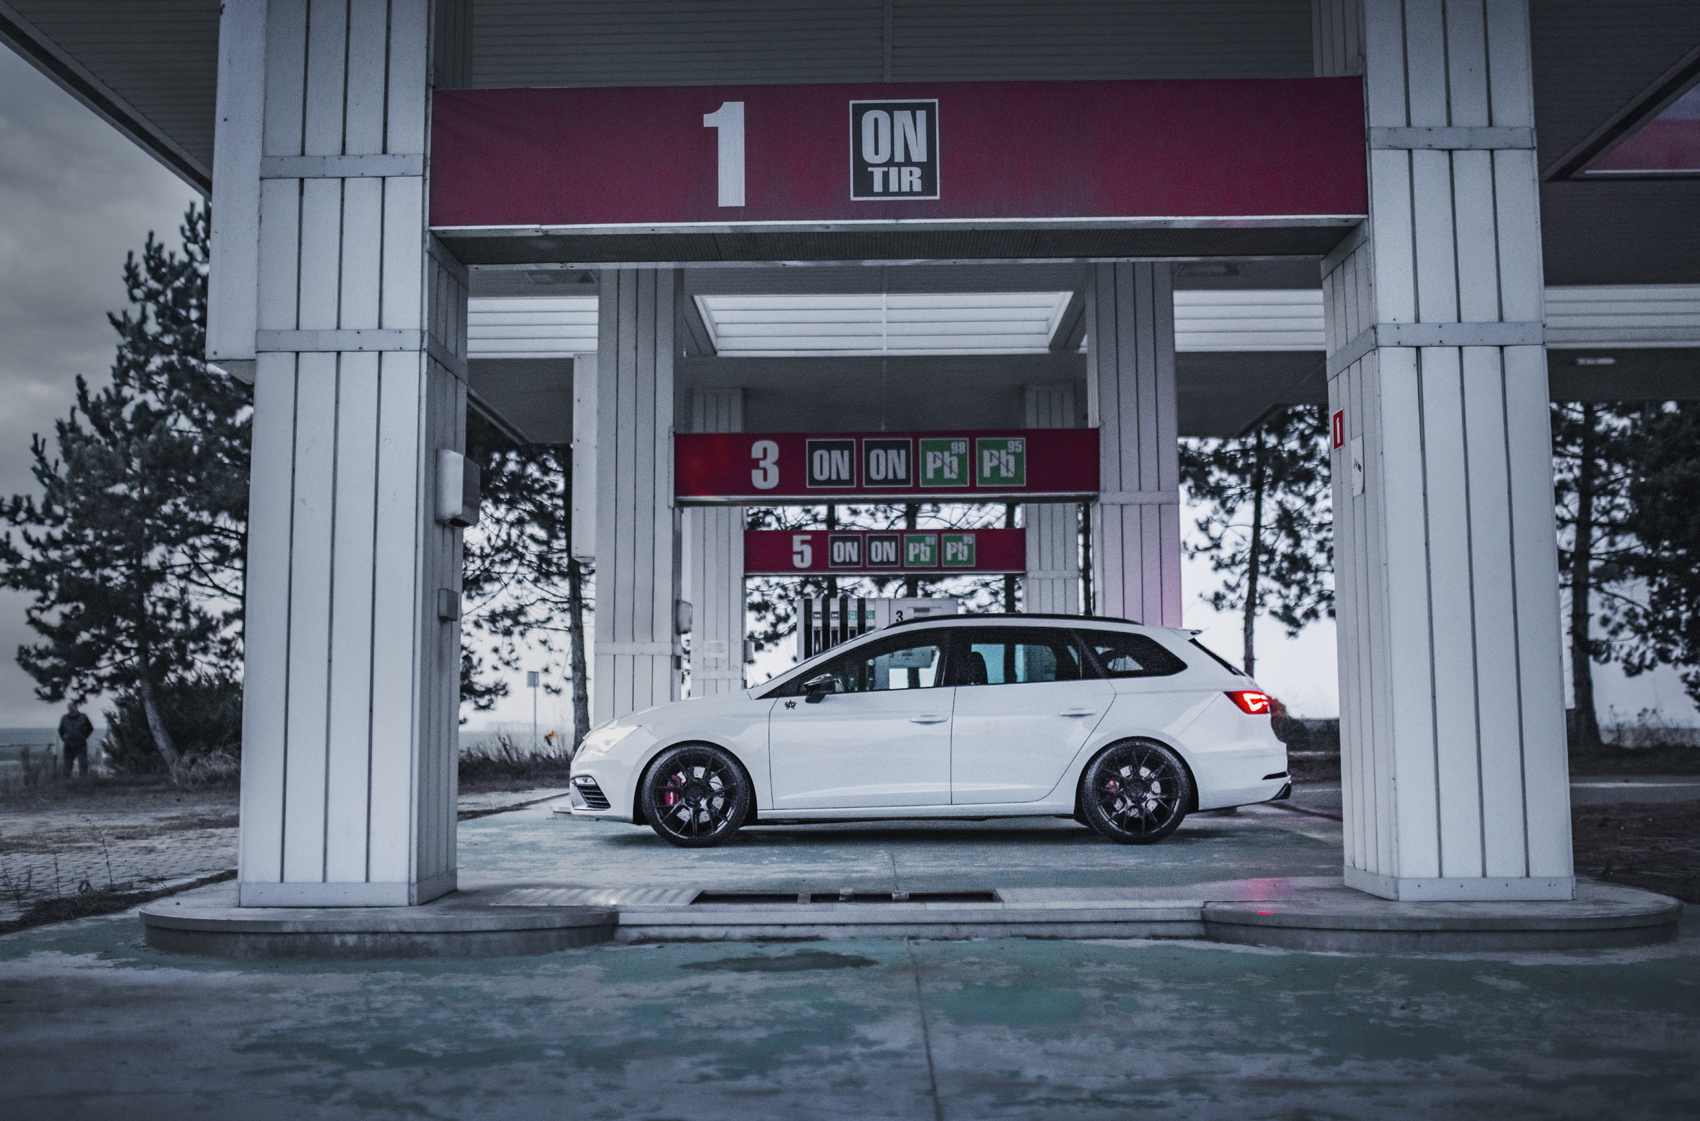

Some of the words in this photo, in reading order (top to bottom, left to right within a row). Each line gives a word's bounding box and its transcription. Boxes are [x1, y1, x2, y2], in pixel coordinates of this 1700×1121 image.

[703, 101, 745, 207] 1
[861, 109, 927, 164] ON
[867, 166, 922, 192] TIR
[751, 439, 779, 490] 3
[812, 449, 850, 481] ON
[869, 449, 907, 480] ON
[926, 450, 958, 479] Pb
[950, 441, 966, 454] 98
[983, 449, 1015, 478] Pb
[1007, 440, 1022, 453] 95
[792, 534, 812, 569] 5
[833, 541, 858, 563] ON
[870, 541, 896, 563] ON
[908, 542, 930, 562] Pb
[946, 542, 968, 561] Pb
[896, 610, 903, 622] 3
